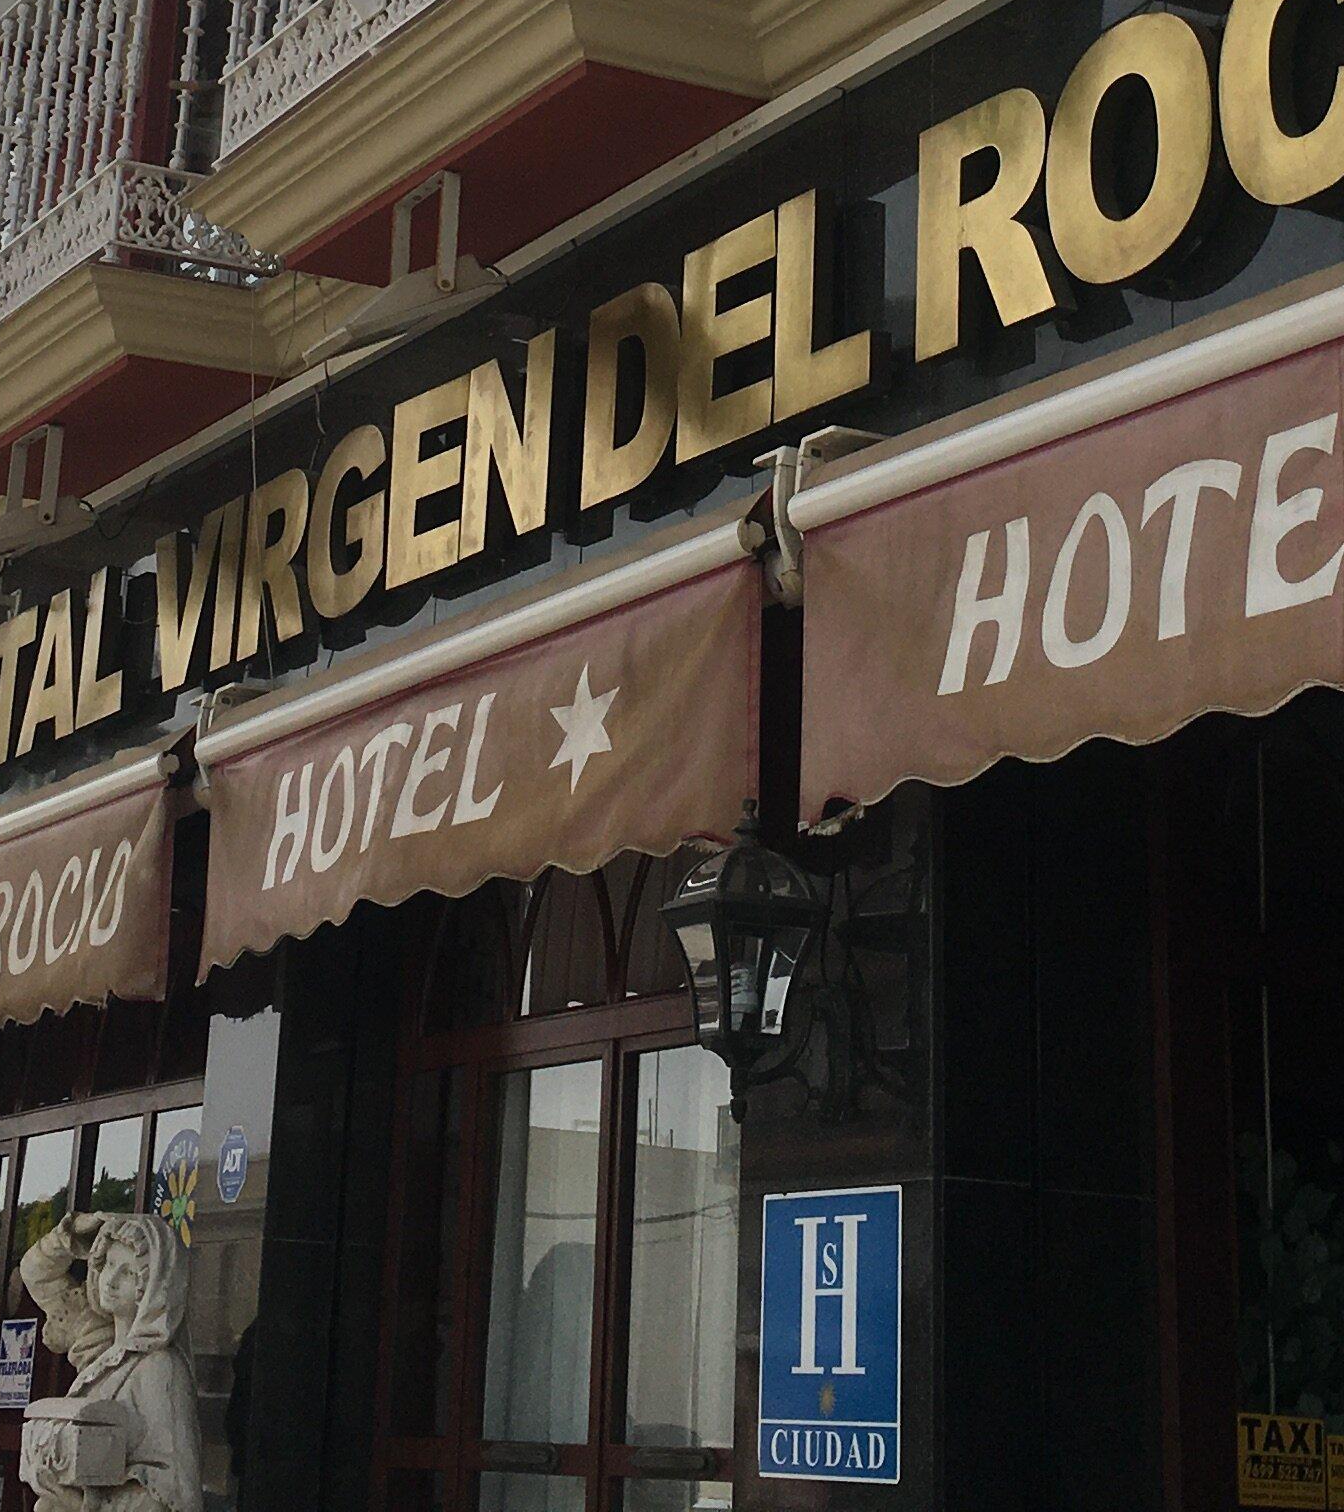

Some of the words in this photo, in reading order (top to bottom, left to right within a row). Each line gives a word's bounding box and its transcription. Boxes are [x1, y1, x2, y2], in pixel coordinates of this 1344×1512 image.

[155, 328, 554, 693] VIRGEN
[580, 188, 870, 509] DEL
[261, 692, 504, 891] HOTEL
[222, 1148, 244, 1174] ADT
[791, 1213, 868, 1375] H
[770, 1428, 886, 1470] CIUDAD
[1240, 1417, 1324, 1455] TAXI
